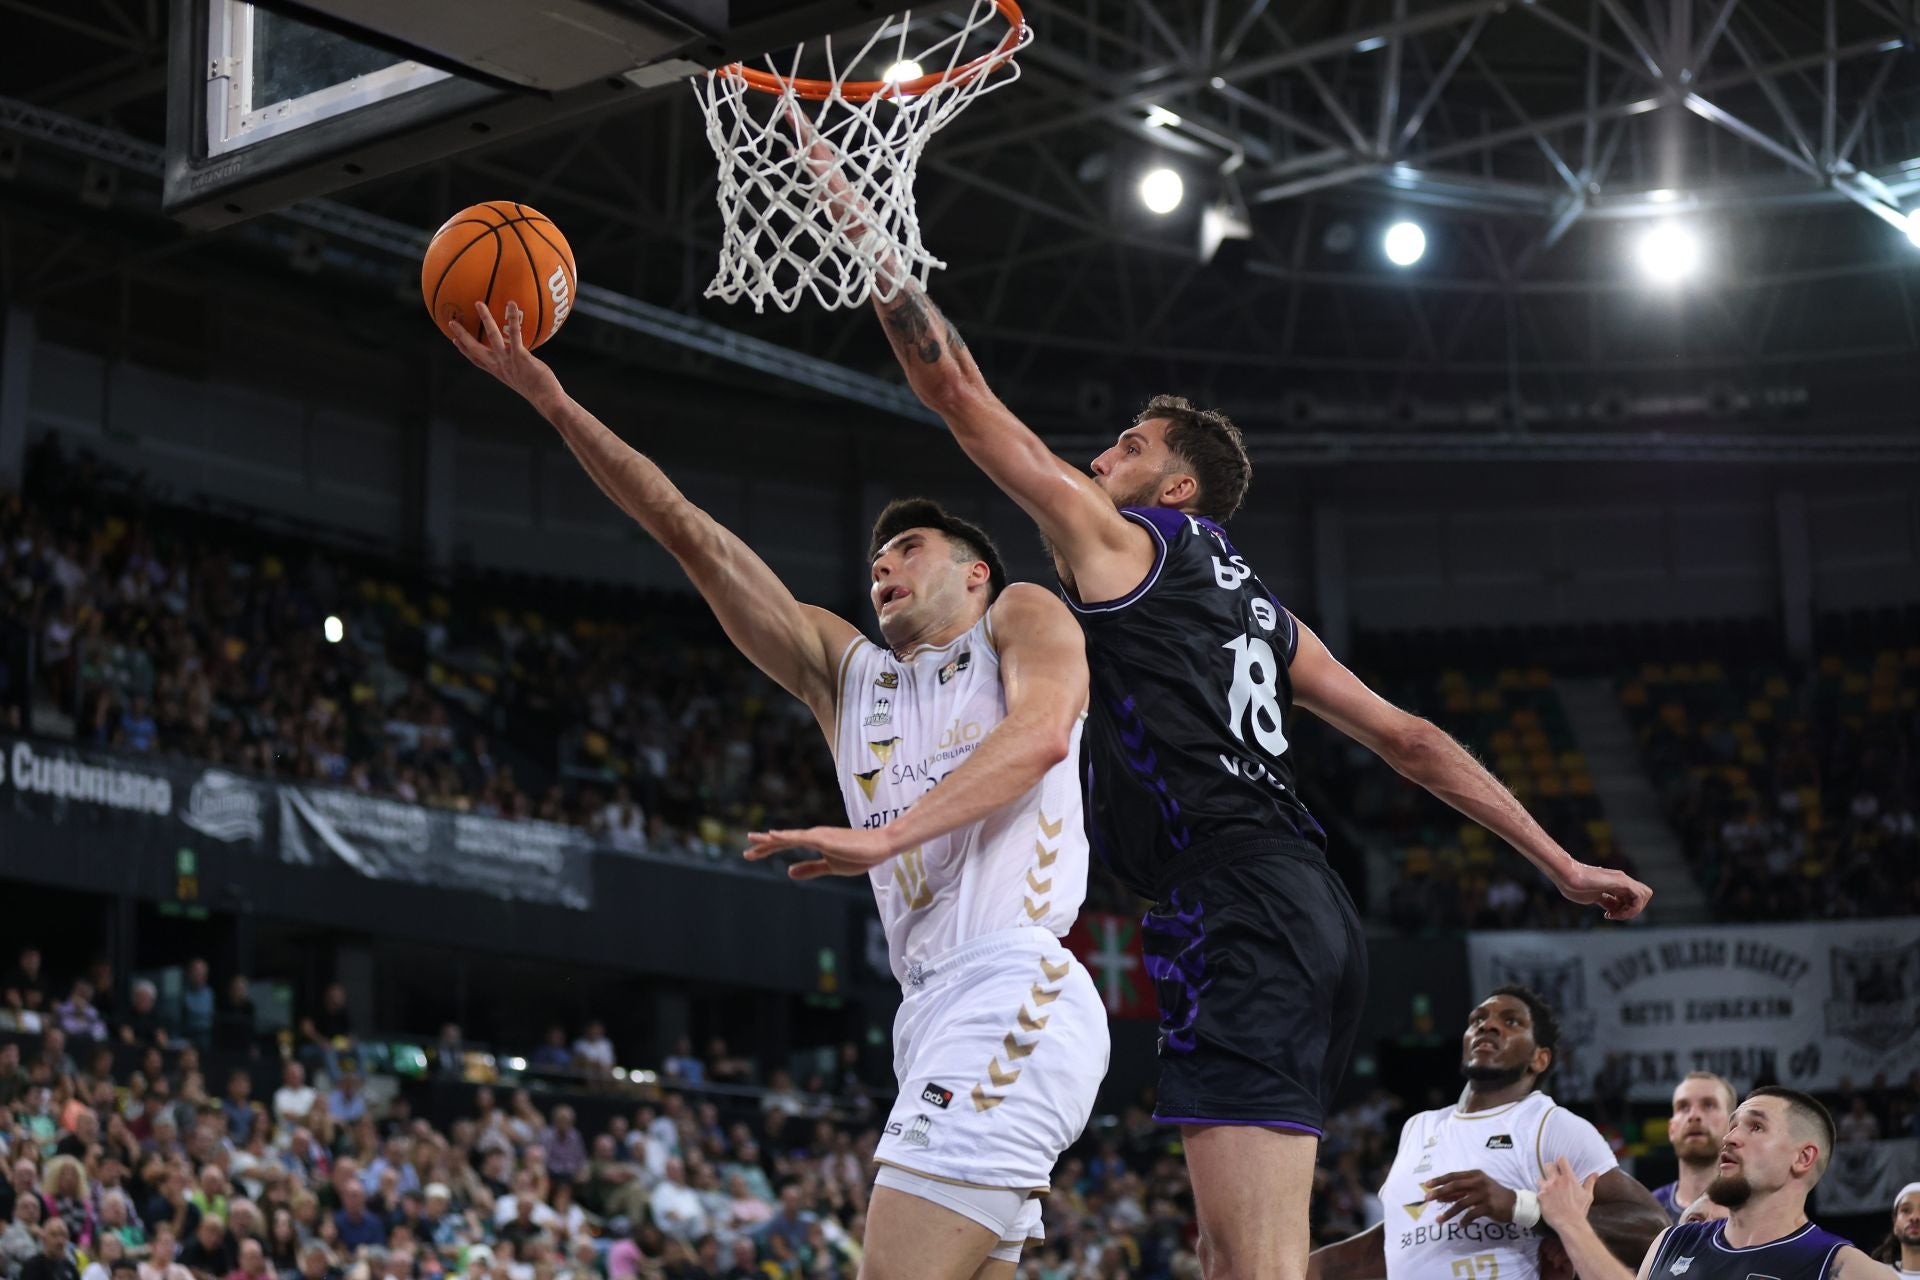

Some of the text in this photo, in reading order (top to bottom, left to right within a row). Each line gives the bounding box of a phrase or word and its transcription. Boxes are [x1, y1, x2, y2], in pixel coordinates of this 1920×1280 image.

[1221, 632, 1289, 757] 18
[891, 759, 928, 786] SAN
[1735, 941, 1809, 988] BASKET
[924, 1090, 943, 1105] acb
[1415, 1222, 1520, 1246] BURGOS
